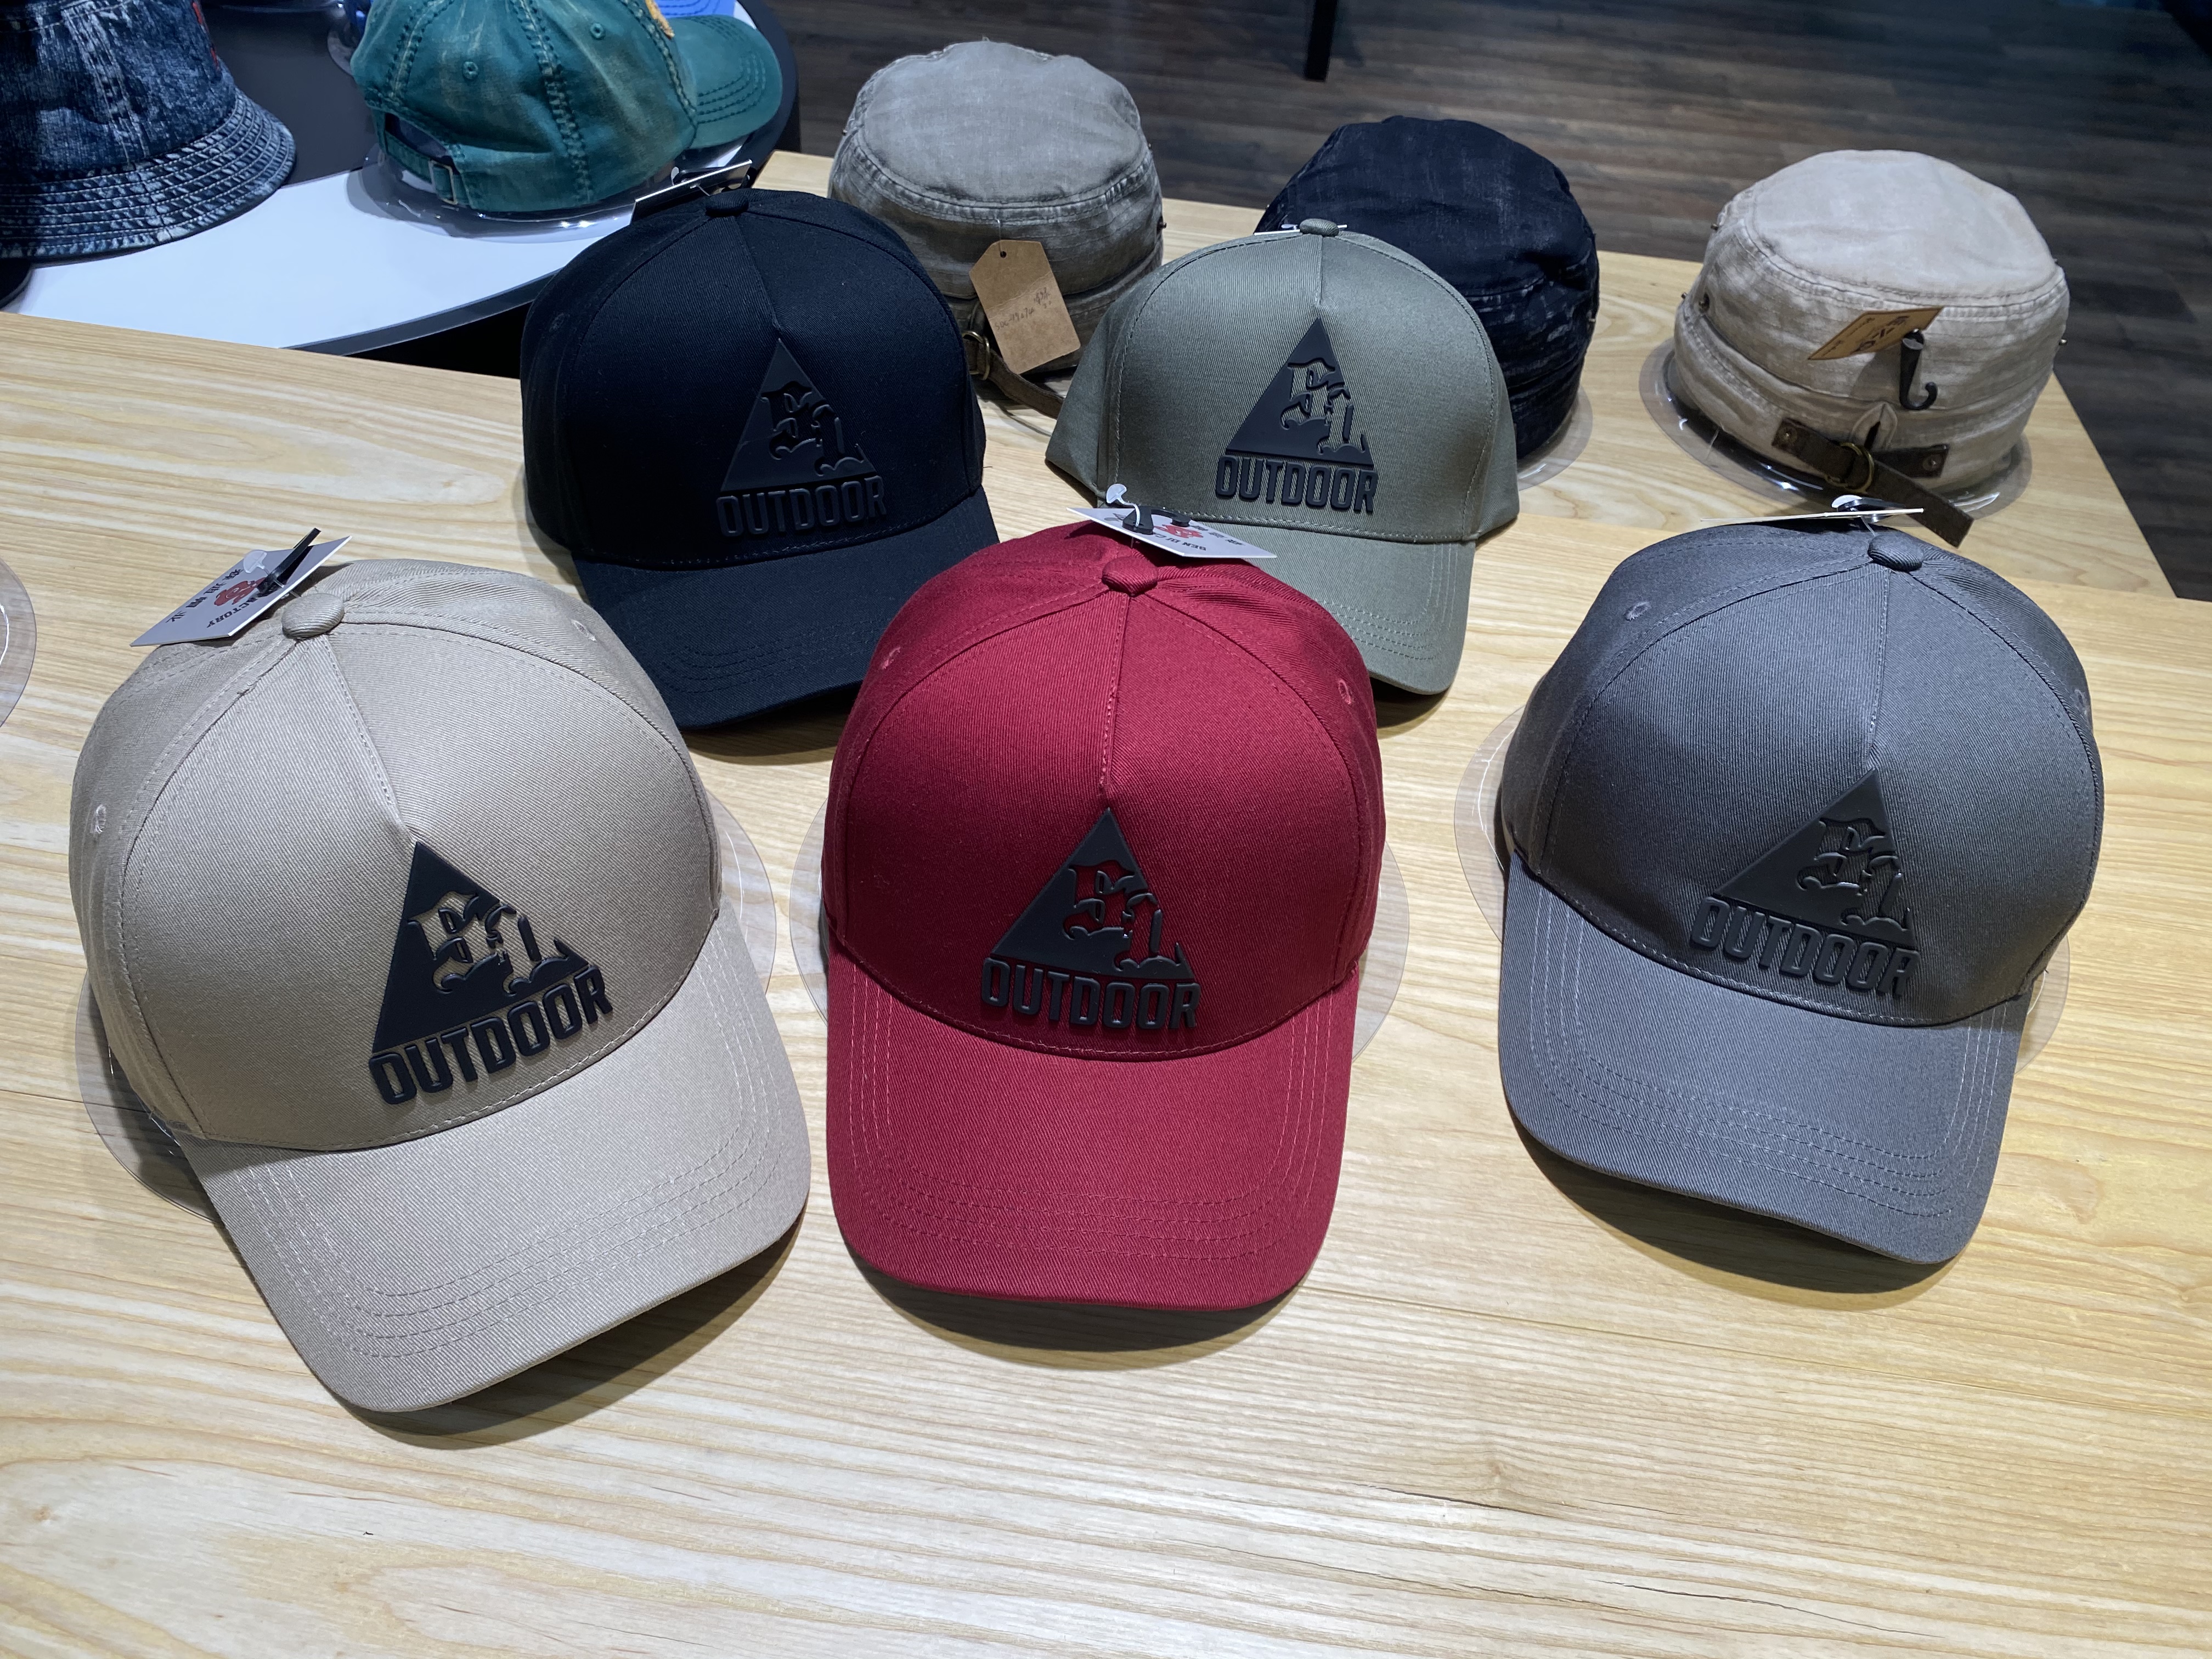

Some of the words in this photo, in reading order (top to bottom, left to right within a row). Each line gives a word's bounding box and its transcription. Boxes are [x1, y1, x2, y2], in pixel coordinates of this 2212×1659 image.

[716, 475, 887, 537] OUTDOOR
[1215, 455, 1379, 512] OUTDOOR
[206, 595, 259, 629] ACTORY
[1690, 896, 1920, 997] OUTDOOR
[981, 957, 1201, 1029] OUTDOOR
[369, 964, 614, 1105] OUTDOOR
